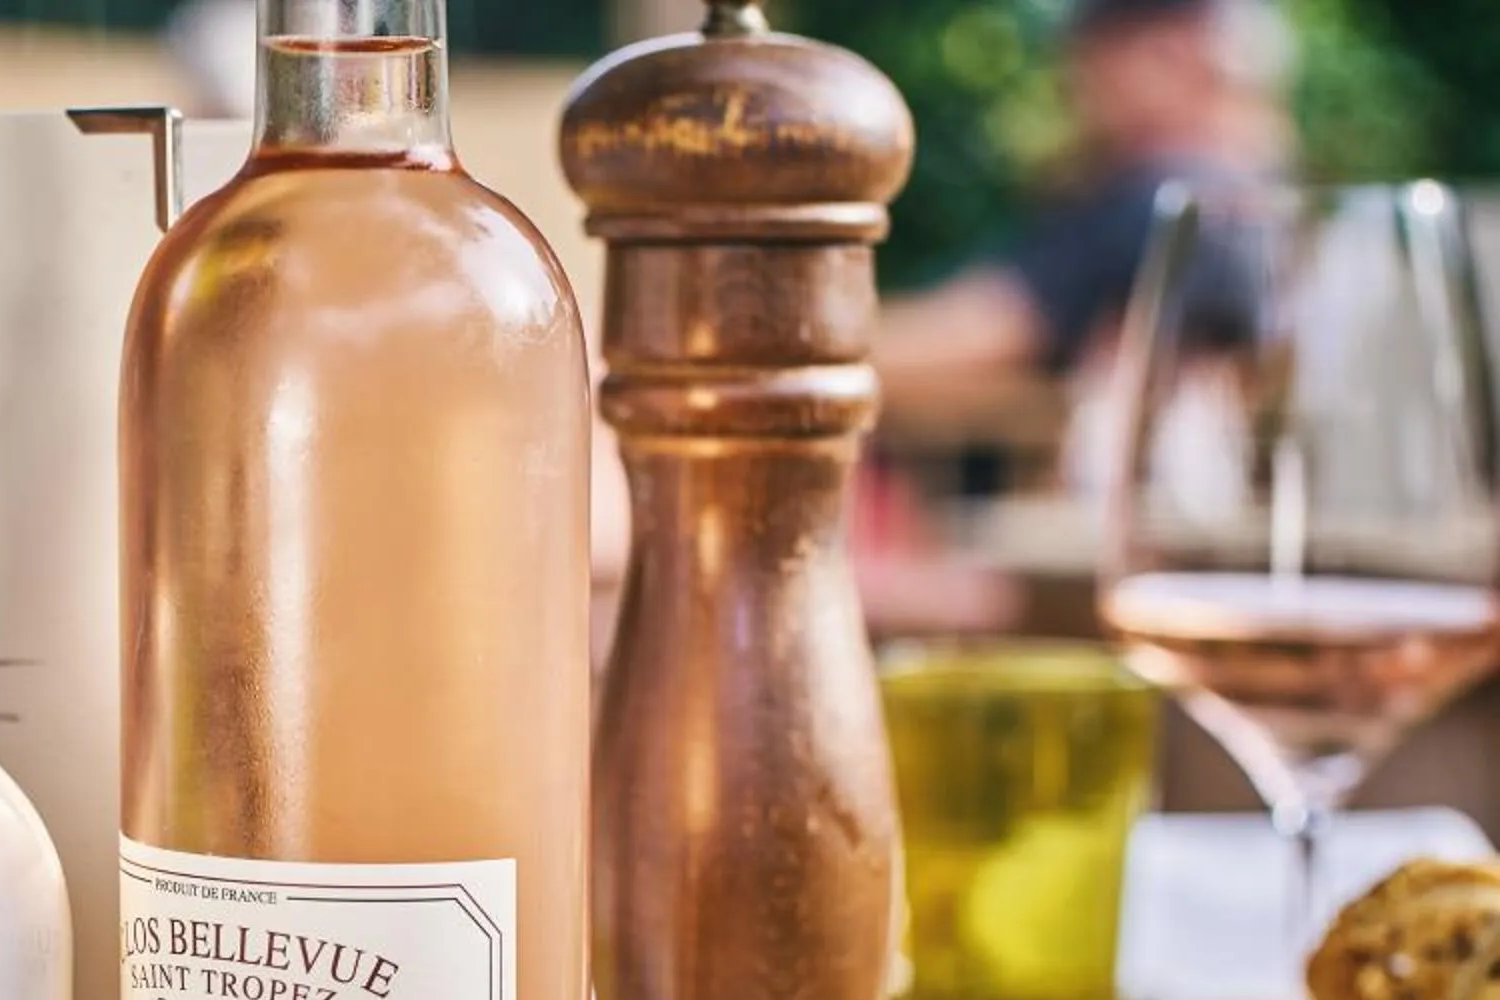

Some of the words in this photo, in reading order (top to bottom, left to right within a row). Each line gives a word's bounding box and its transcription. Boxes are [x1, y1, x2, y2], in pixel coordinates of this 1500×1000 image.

[155, 878, 198, 897] PRODUIT
[201, 886, 219, 899] DE
[221, 888, 277, 904] FRANCE
[120, 917, 160, 962] LOS
[168, 918, 399, 999] BELLEVUE
[131, 963, 190, 991] SAINT
